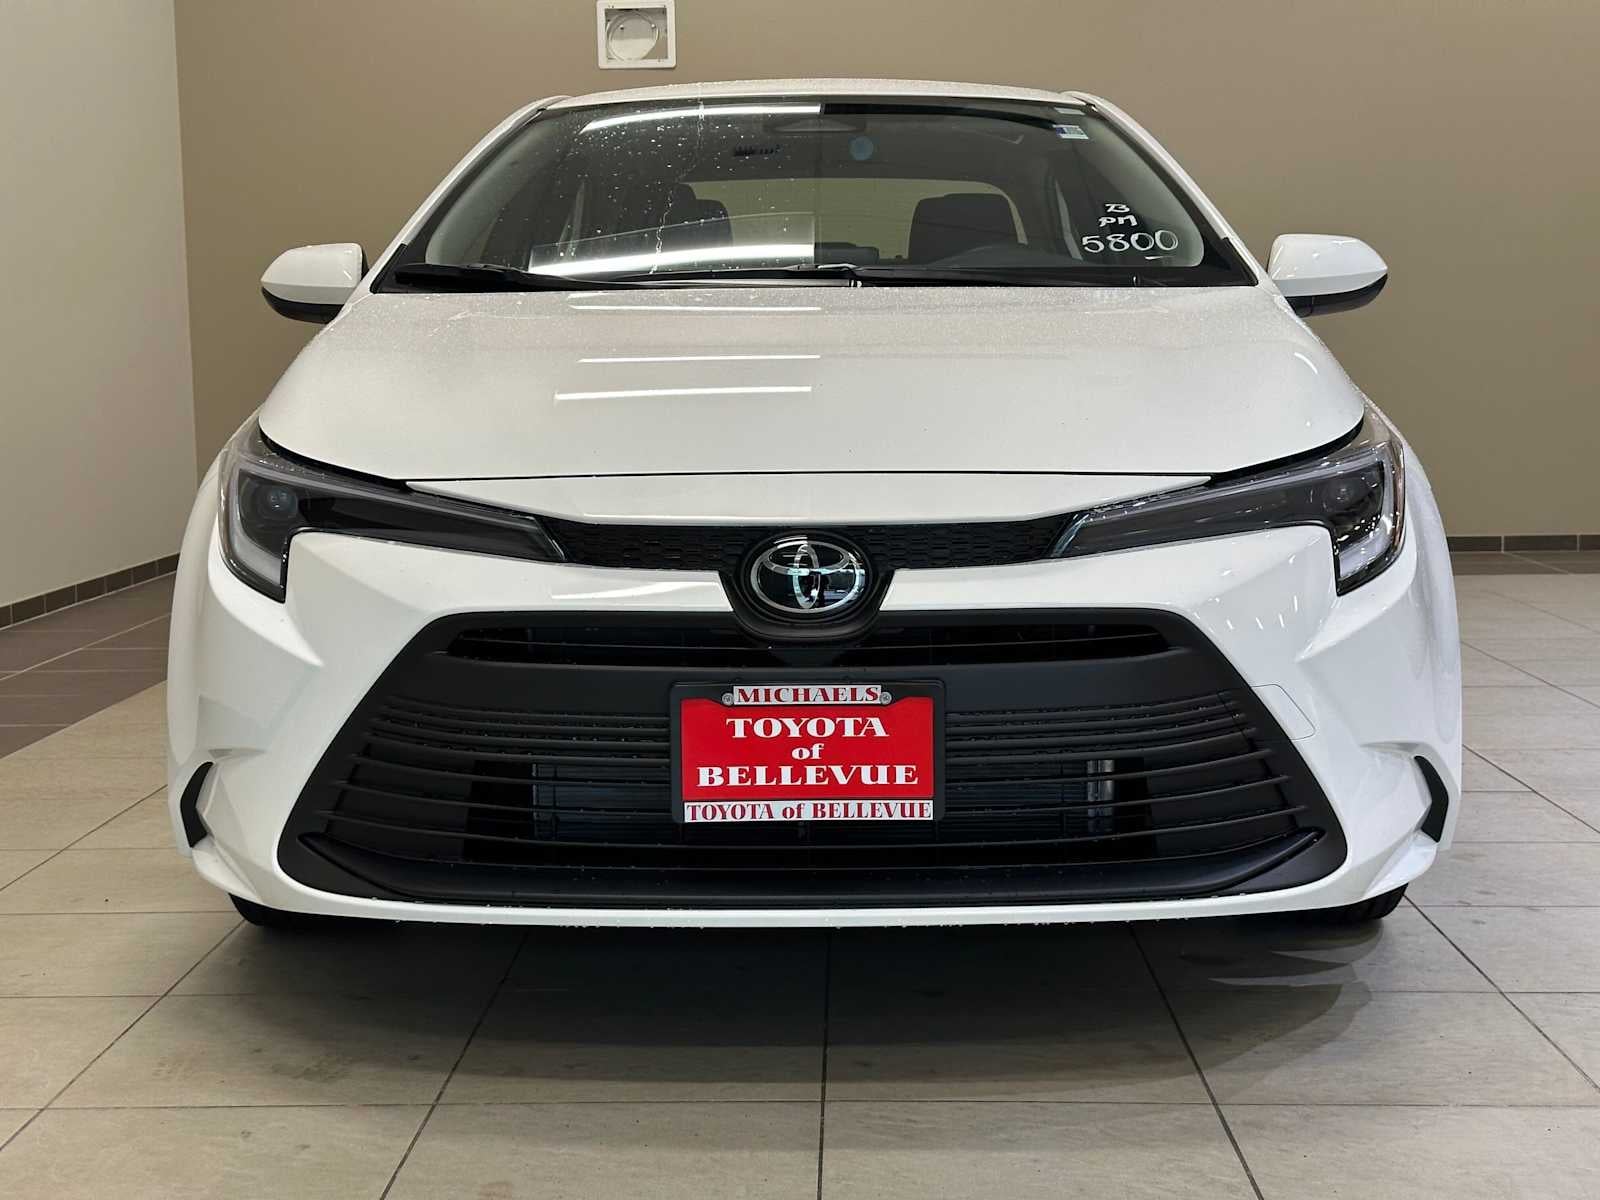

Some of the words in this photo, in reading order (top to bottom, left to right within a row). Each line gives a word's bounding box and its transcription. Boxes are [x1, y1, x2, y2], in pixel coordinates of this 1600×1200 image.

[1081, 230, 1179, 253] 5800
[737, 686, 880, 703] MICHAELS
[726, 717, 889, 739] TOYOTA
[791, 743, 825, 760] of
[696, 764, 919, 787] BELLEVUE
[686, 803, 774, 821] TOYOTA
[782, 802, 805, 820] of
[812, 802, 932, 819] BELLEVUE
